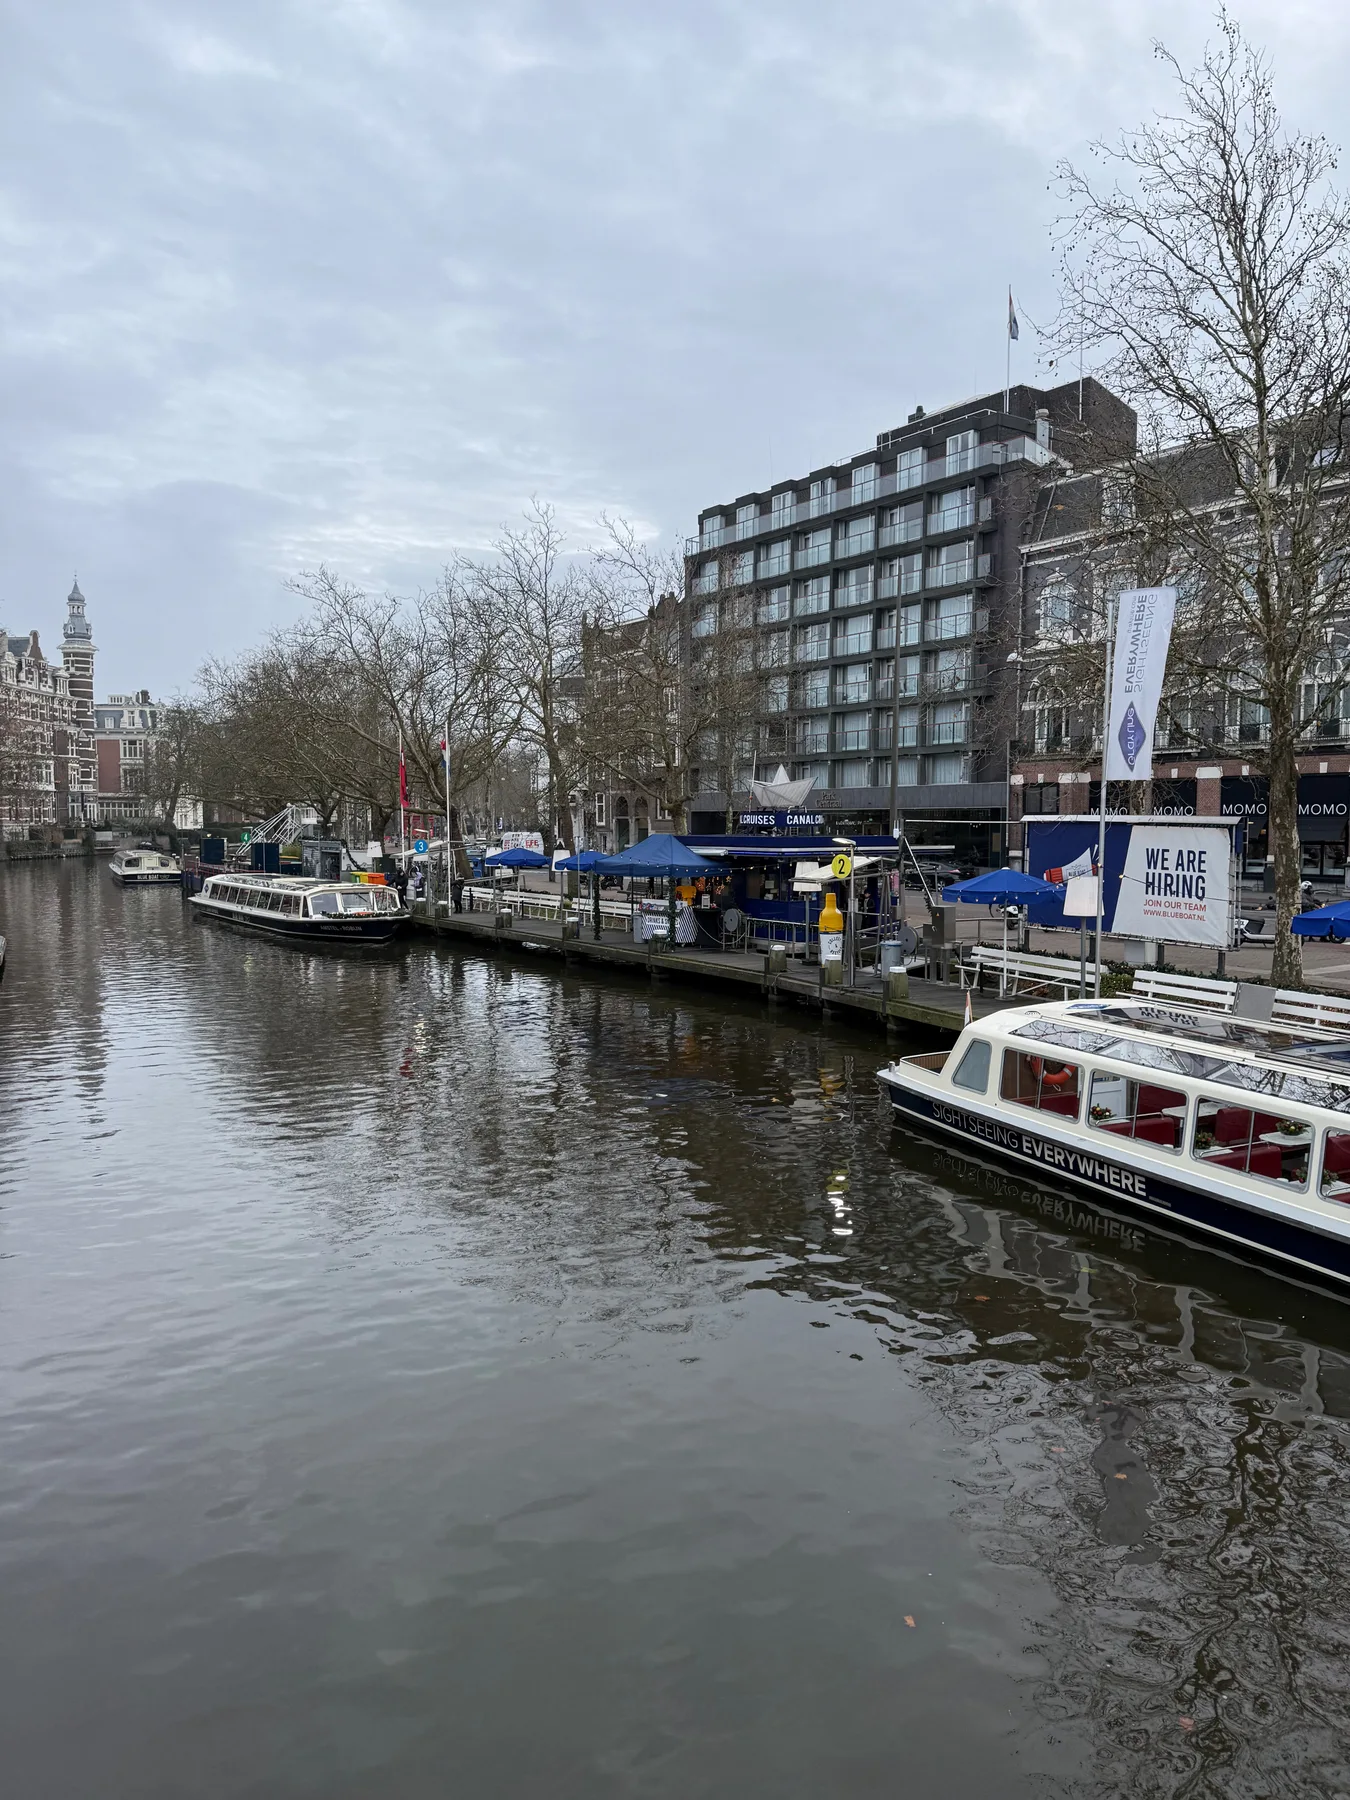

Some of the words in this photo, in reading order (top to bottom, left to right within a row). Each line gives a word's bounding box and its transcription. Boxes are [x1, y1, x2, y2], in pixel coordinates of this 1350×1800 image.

[1153, 805, 1194, 816] MOMO
[1222, 803, 1267, 815] MOMO
[1298, 803, 1348, 815] MOMO
[786, 814, 815, 825] CANAL
[419, 841, 424, 851] 3
[838, 858, 846, 875] 2
[1145, 847, 1170, 871] WE
[1175, 849, 1207, 873] ARE
[1144, 871, 1206, 901] HIRING
[1143, 899, 1162, 908] JOIN
[1164, 900, 1182, 910] OUR
[1184, 902, 1207, 912] TEAM
[1143, 908, 1207, 922] WWW.BLUEBOAT.NL
[932, 1102, 1019, 1149] SIGHTSEEING
[1022, 1134, 1147, 1197] EVERYWHERE
